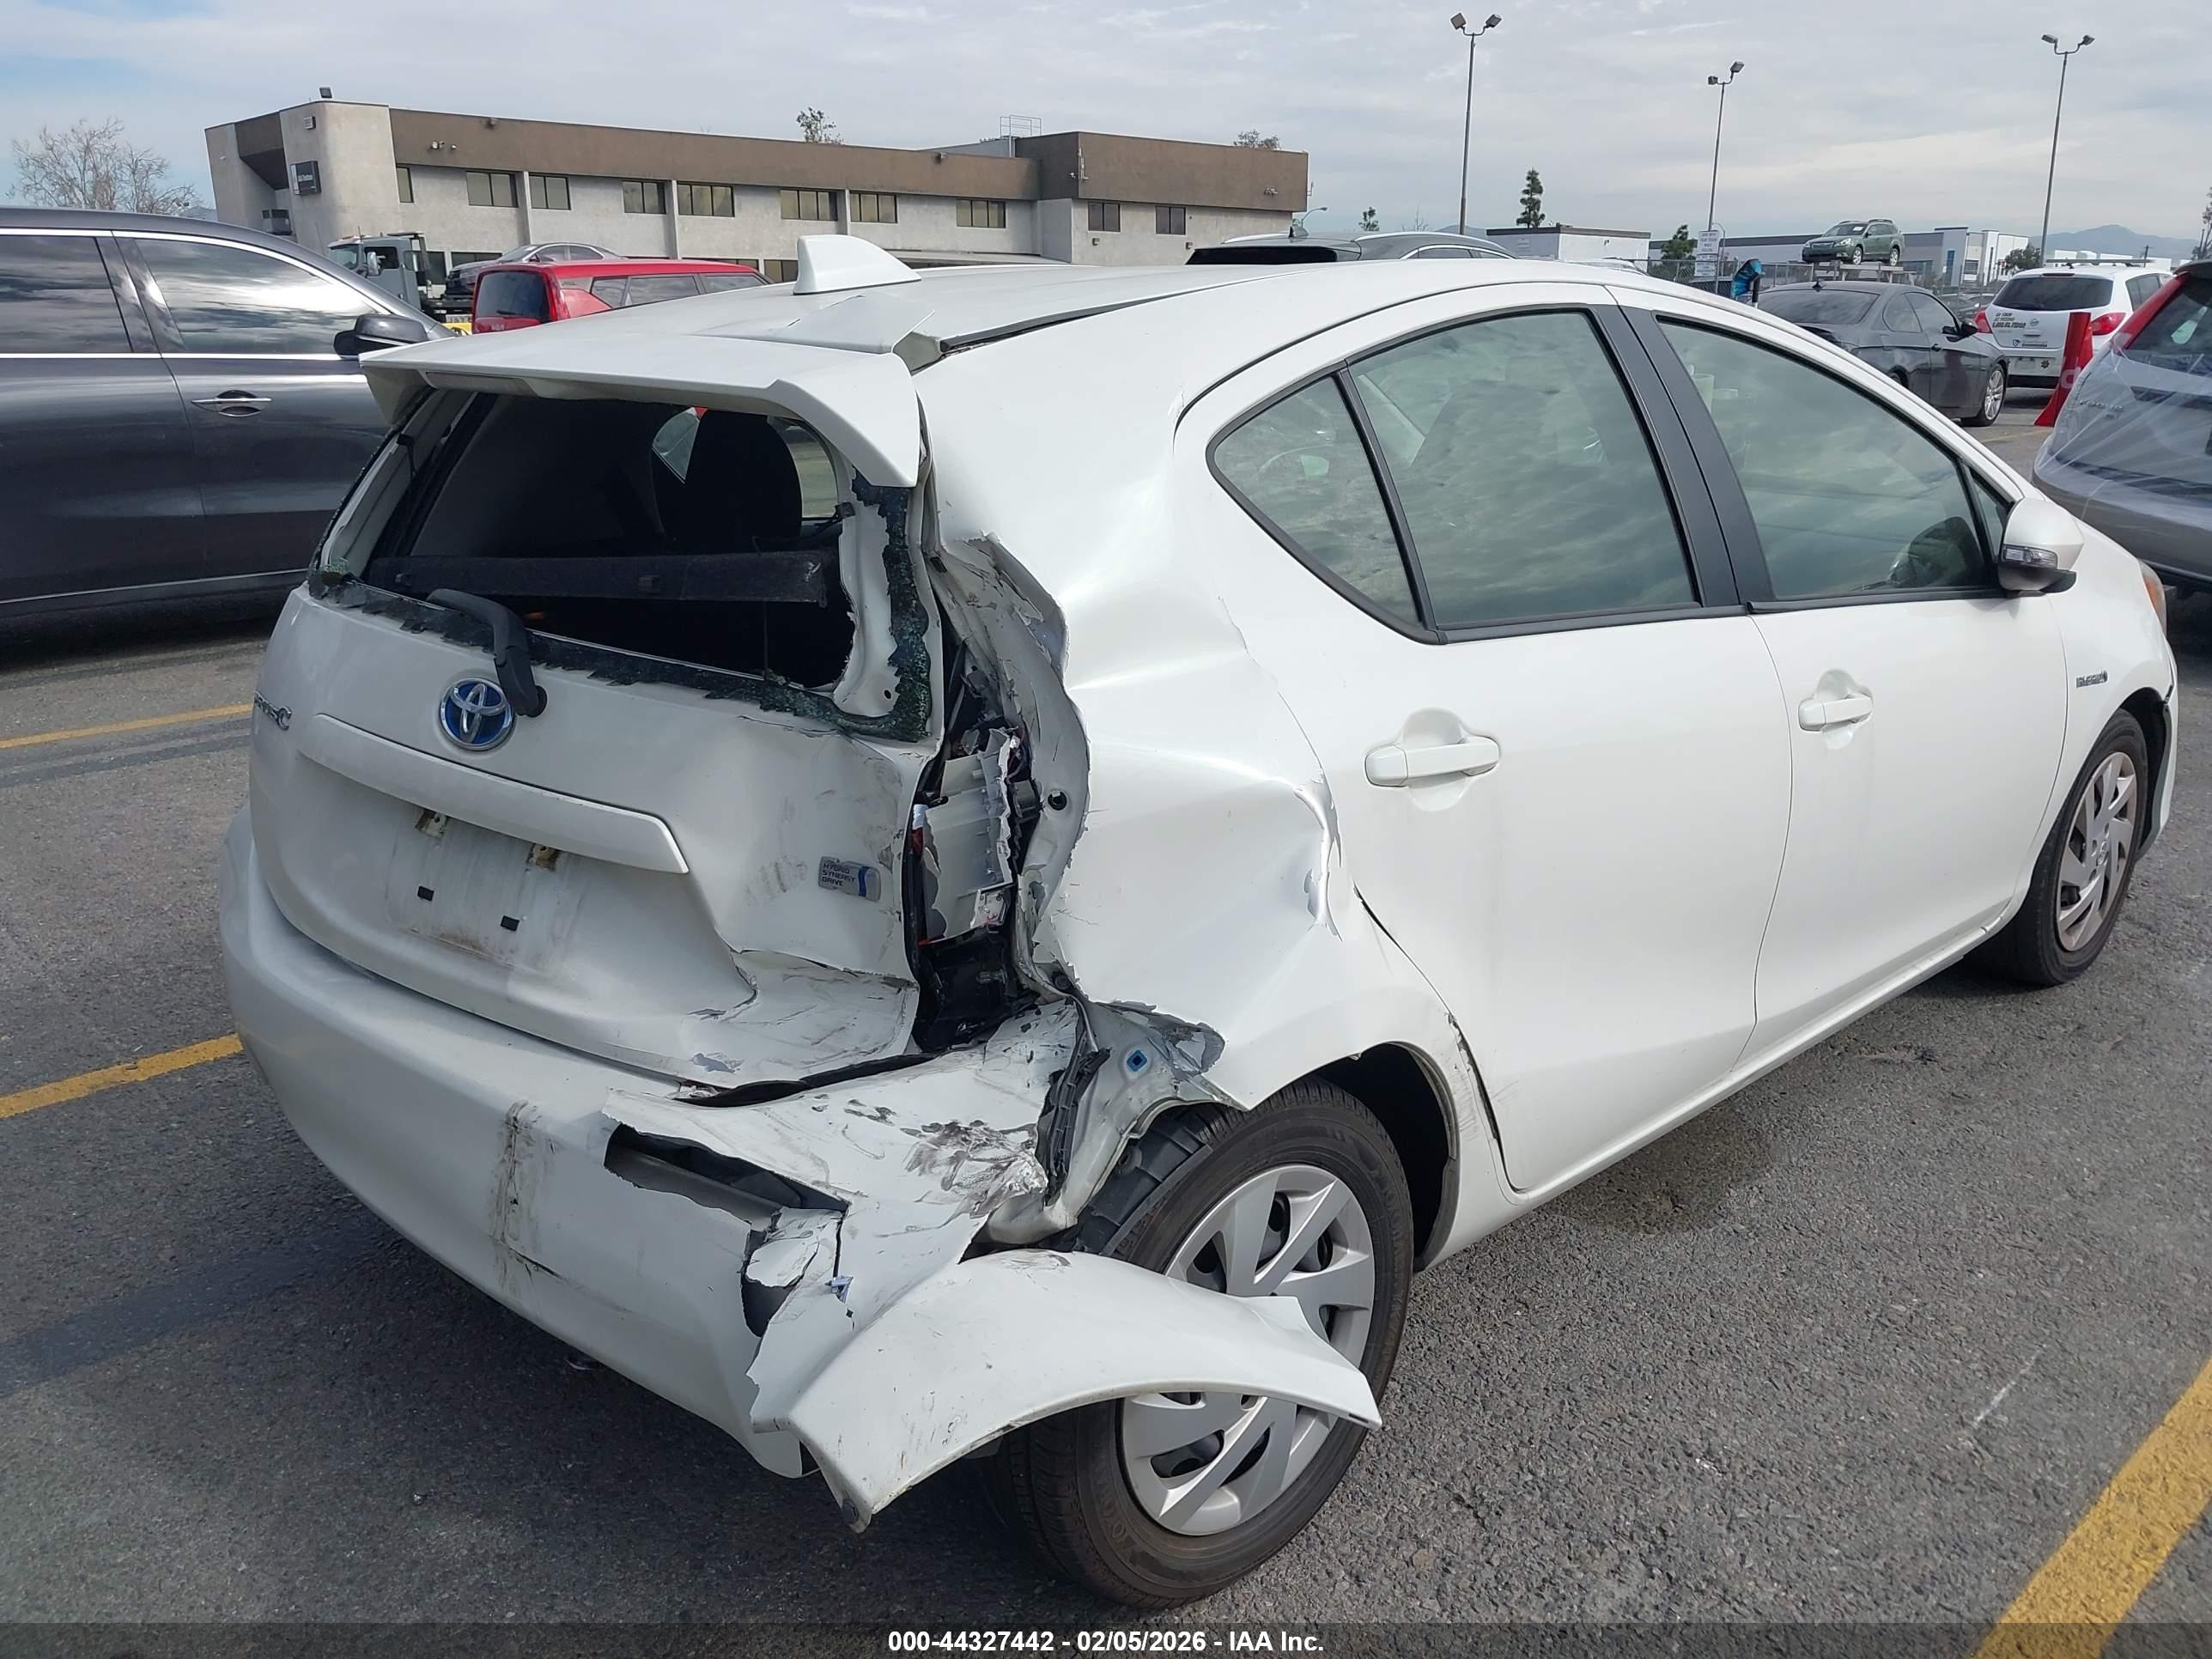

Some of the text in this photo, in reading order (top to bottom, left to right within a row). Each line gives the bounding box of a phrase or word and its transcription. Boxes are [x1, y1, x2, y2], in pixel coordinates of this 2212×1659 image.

[823, 863, 850, 874] HYBRID
[822, 869, 856, 883] SYNERGY
[821, 877, 845, 887] DRIVE
